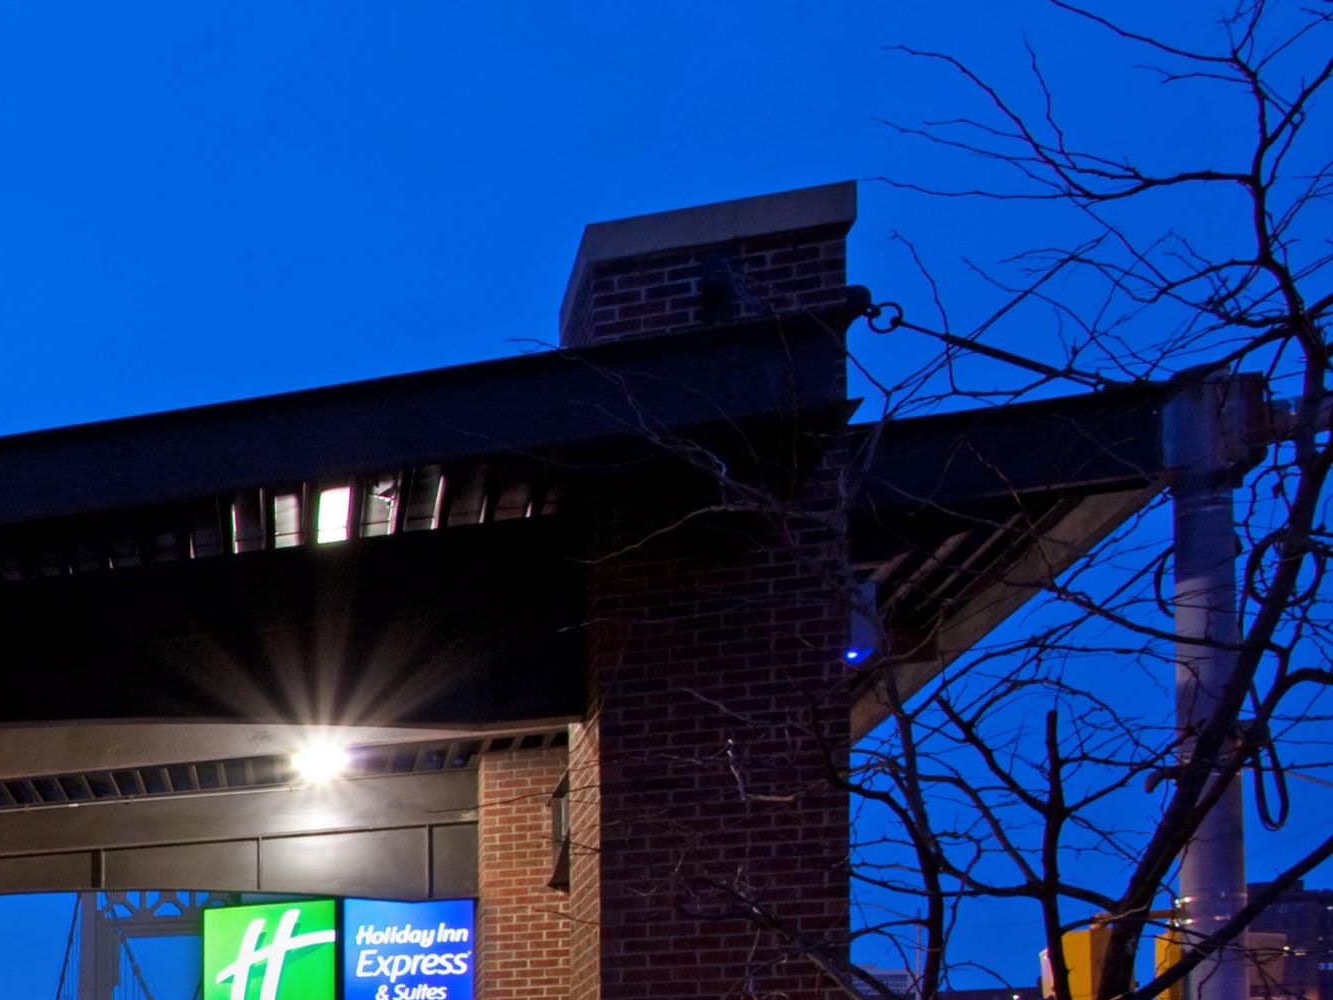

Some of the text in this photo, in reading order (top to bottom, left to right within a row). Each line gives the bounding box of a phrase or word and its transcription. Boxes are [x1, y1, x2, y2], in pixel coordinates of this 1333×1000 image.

[355, 922, 469, 948] Holiday Inn
[356, 949, 469, 983] Express
[392, 983, 447, 1000] Suites
